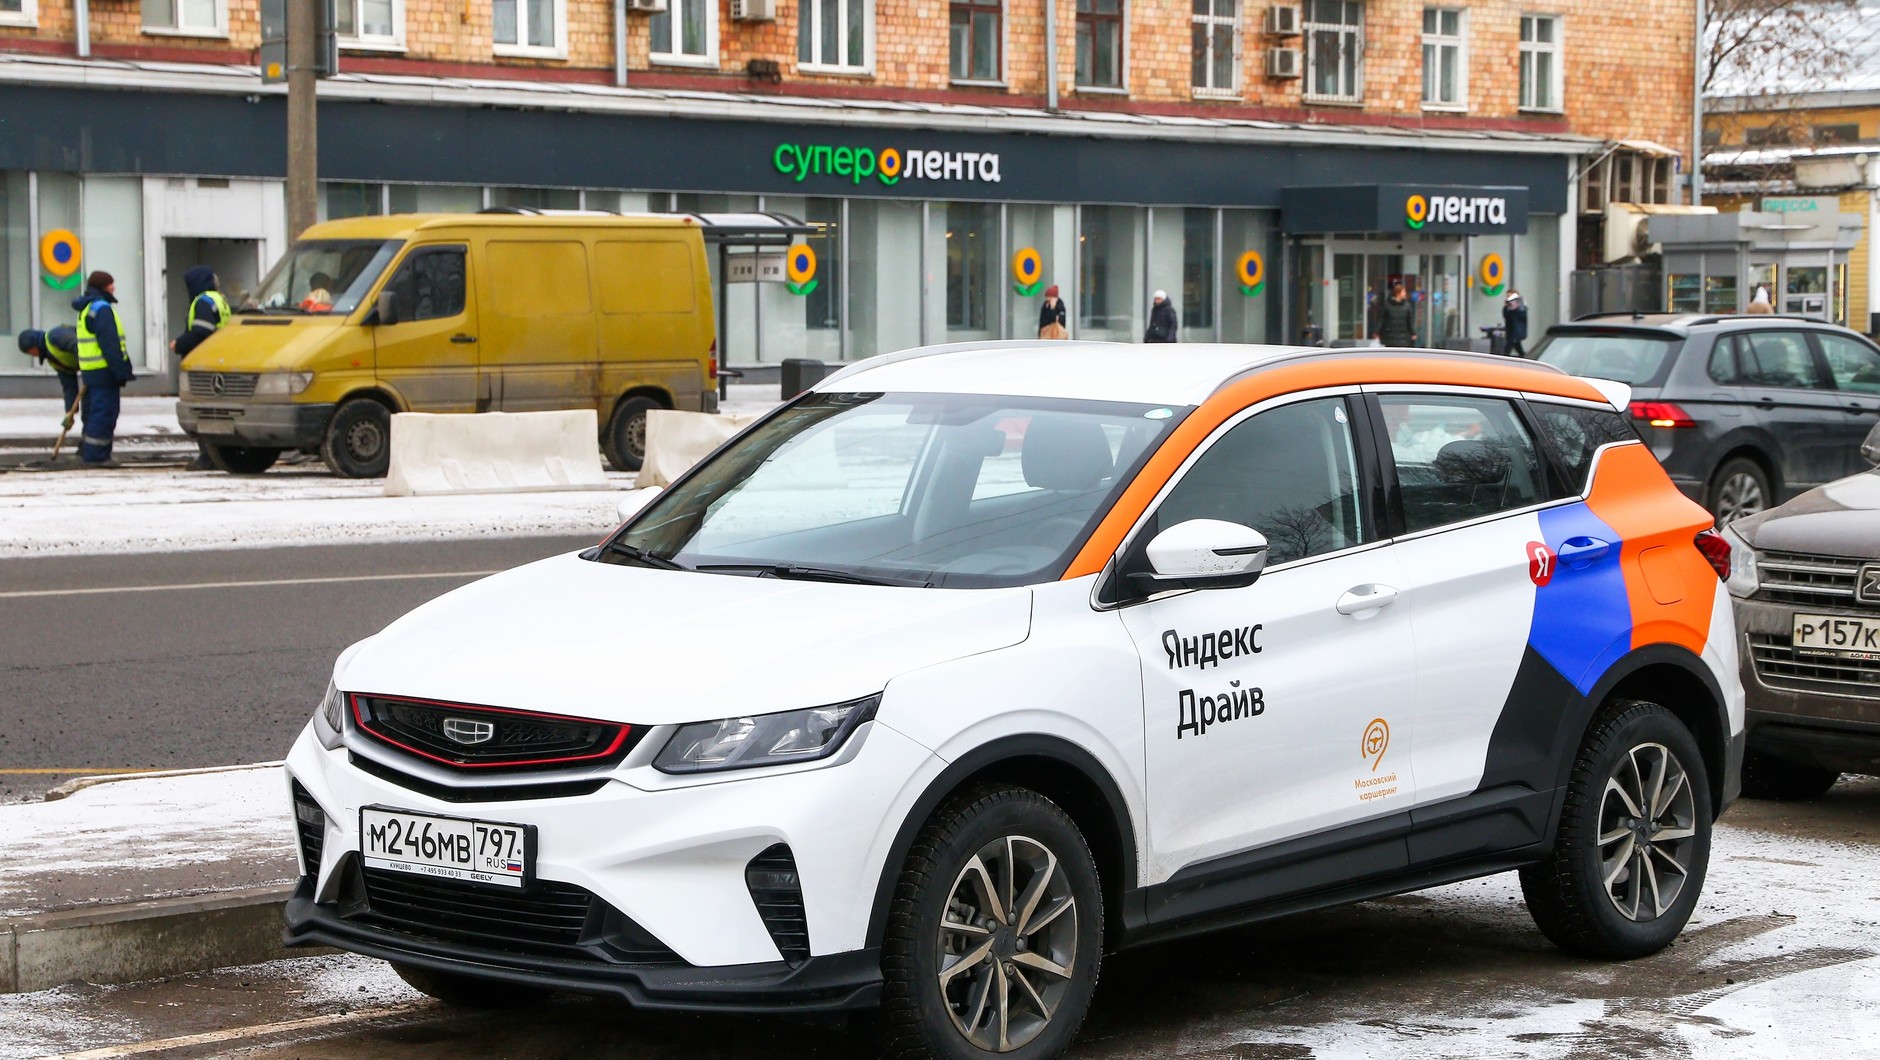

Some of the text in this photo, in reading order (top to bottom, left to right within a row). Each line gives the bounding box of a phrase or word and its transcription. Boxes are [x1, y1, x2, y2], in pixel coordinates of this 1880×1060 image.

[774, 143, 1001, 184] супер лента
[1426, 196, 1507, 225] лента
[1161, 623, 1263, 670] Яндекс
[1177, 679, 1265, 740] Драйв
[1354, 772, 1397, 789] Московский
[1359, 786, 1398, 801] каршеринг
[370, 818, 516, 863] М246МВ 797
[389, 863, 412, 871] КУНЦЕВО
[470, 873, 493, 881] GEELY
[486, 857, 507, 870] RUS
